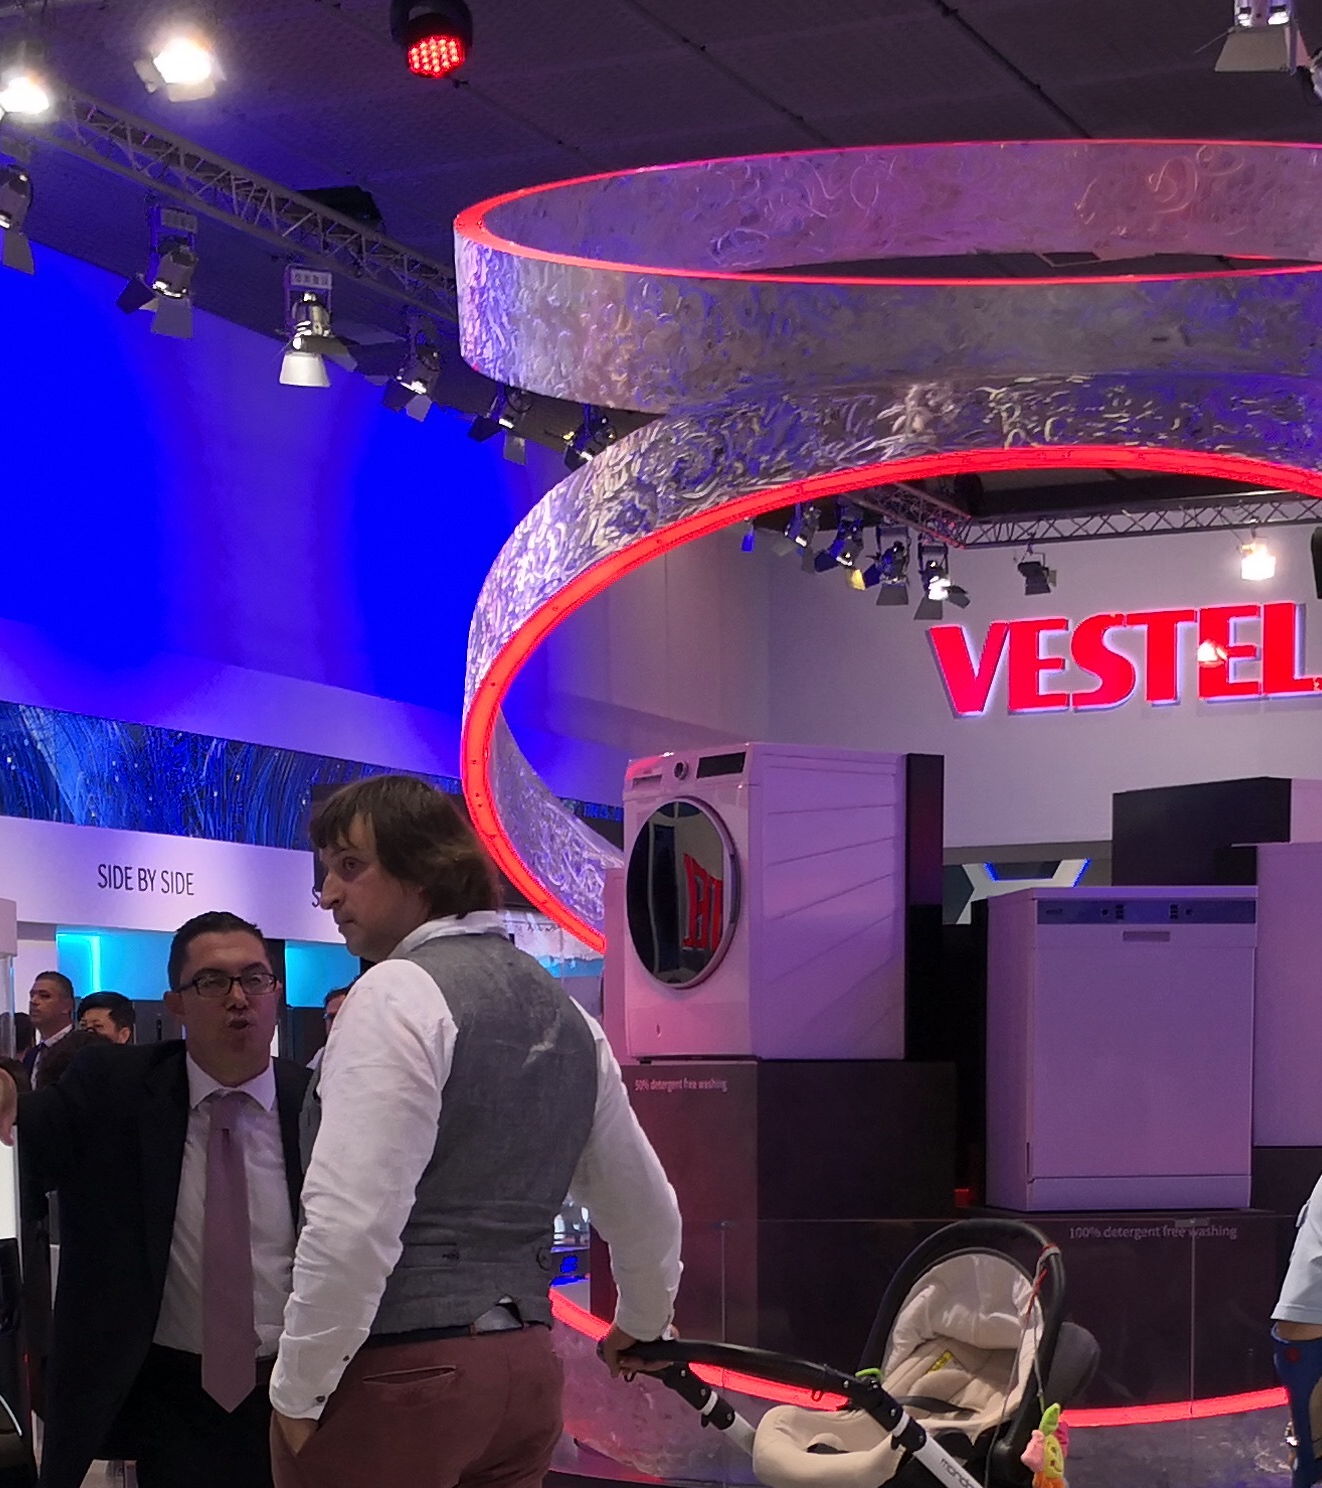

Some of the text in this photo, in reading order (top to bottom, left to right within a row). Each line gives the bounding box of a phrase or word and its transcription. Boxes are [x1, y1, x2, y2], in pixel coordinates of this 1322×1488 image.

[98, 864, 195, 896] SIDE BY SIDE
[1069, 1224, 1238, 1241] 100% detergent free washing
